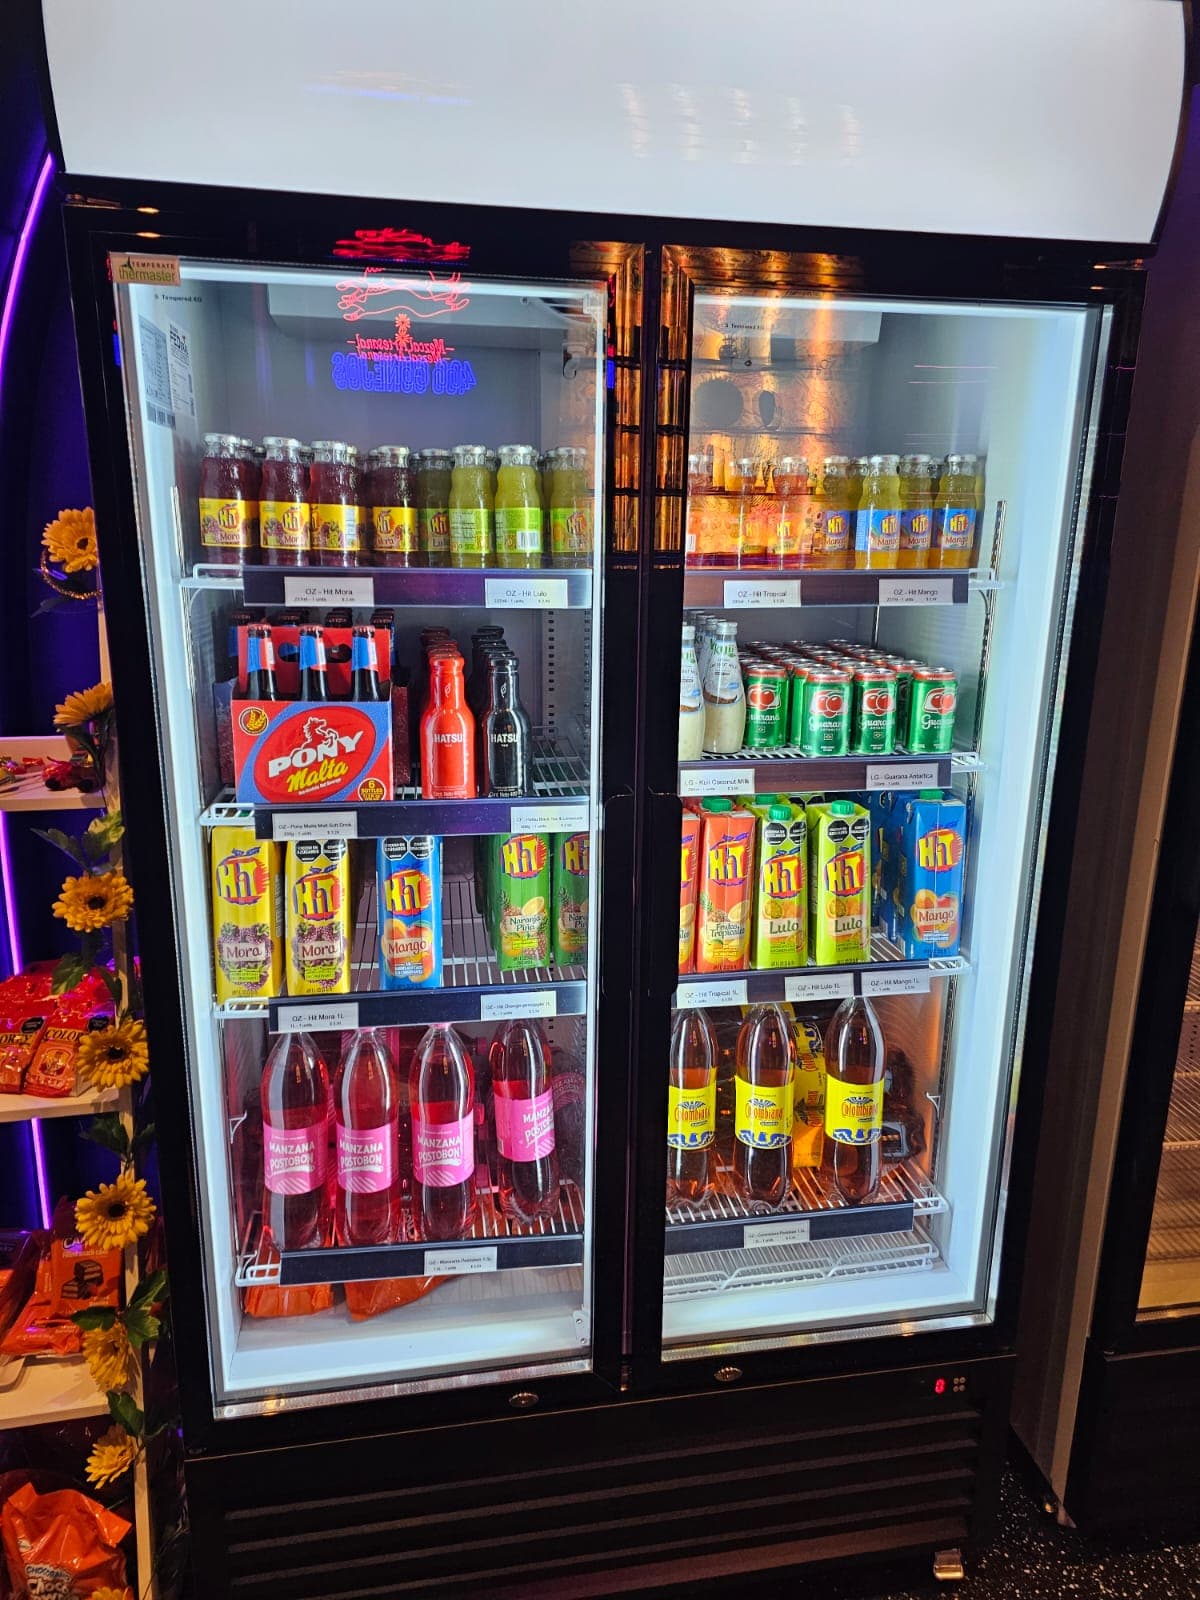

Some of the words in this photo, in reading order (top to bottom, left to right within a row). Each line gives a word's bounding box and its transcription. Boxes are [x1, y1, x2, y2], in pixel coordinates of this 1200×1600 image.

[131, 261, 176, 269] TEMPERATE
[119, 267, 176, 282] thermaster
[433, 732, 464, 744] HATSU
[268, 730, 364, 778] PONY
[287, 759, 349, 793] Malta
[368, 780, 376, 789] 6
[502, 838, 538, 874] HiT
[918, 835, 955, 868] HiT
[708, 845, 744, 881] HiT
[219, 861, 258, 899] HiT
[762, 858, 799, 894] HiT
[826, 857, 861, 893] HiT
[296, 878, 335, 916] HiT
[384, 874, 423, 912] HiT
[834, 918, 863, 933] Lulo
[918, 909, 954, 925] Mango
[769, 918, 799, 935] Lulo
[226, 946, 262, 958] Mora
[302, 943, 338, 958] Mora
[388, 939, 428, 955] Mango
[523, 1103, 553, 1124] MANZA
[269, 1140, 315, 1154] MANZANA
[339, 1140, 384, 1155] MANZANA
[417, 1134, 462, 1149] MANZANA
[270, 1152, 315, 1171] POSTOBON
[340, 1153, 384, 1168] POSTOBON
[418, 1146, 461, 1163] POSTOBON
